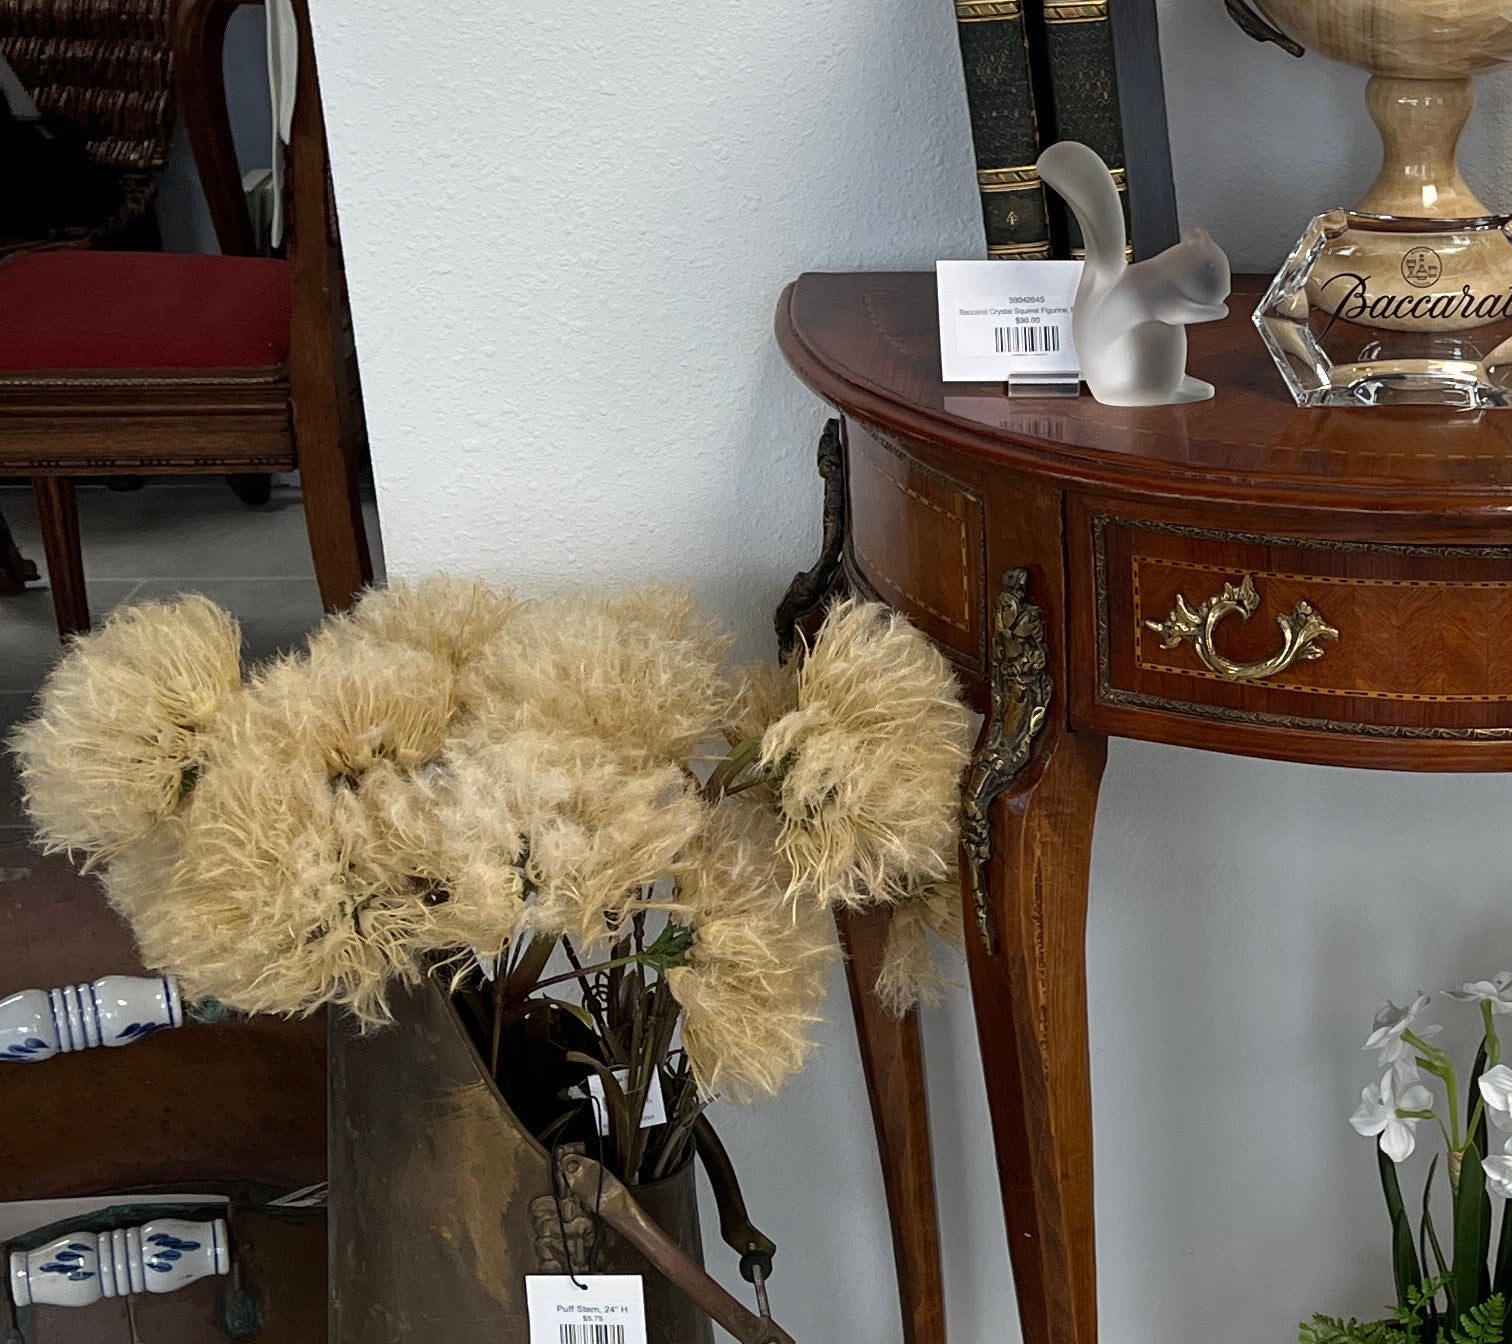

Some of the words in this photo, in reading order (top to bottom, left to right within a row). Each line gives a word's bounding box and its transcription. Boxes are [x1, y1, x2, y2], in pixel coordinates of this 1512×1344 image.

[989, 308, 1012, 317] Crystal
[556, 1304, 575, 1313] Puff
[576, 1305, 602, 1314] Stem,
[620, 1305, 628, 1313] H
